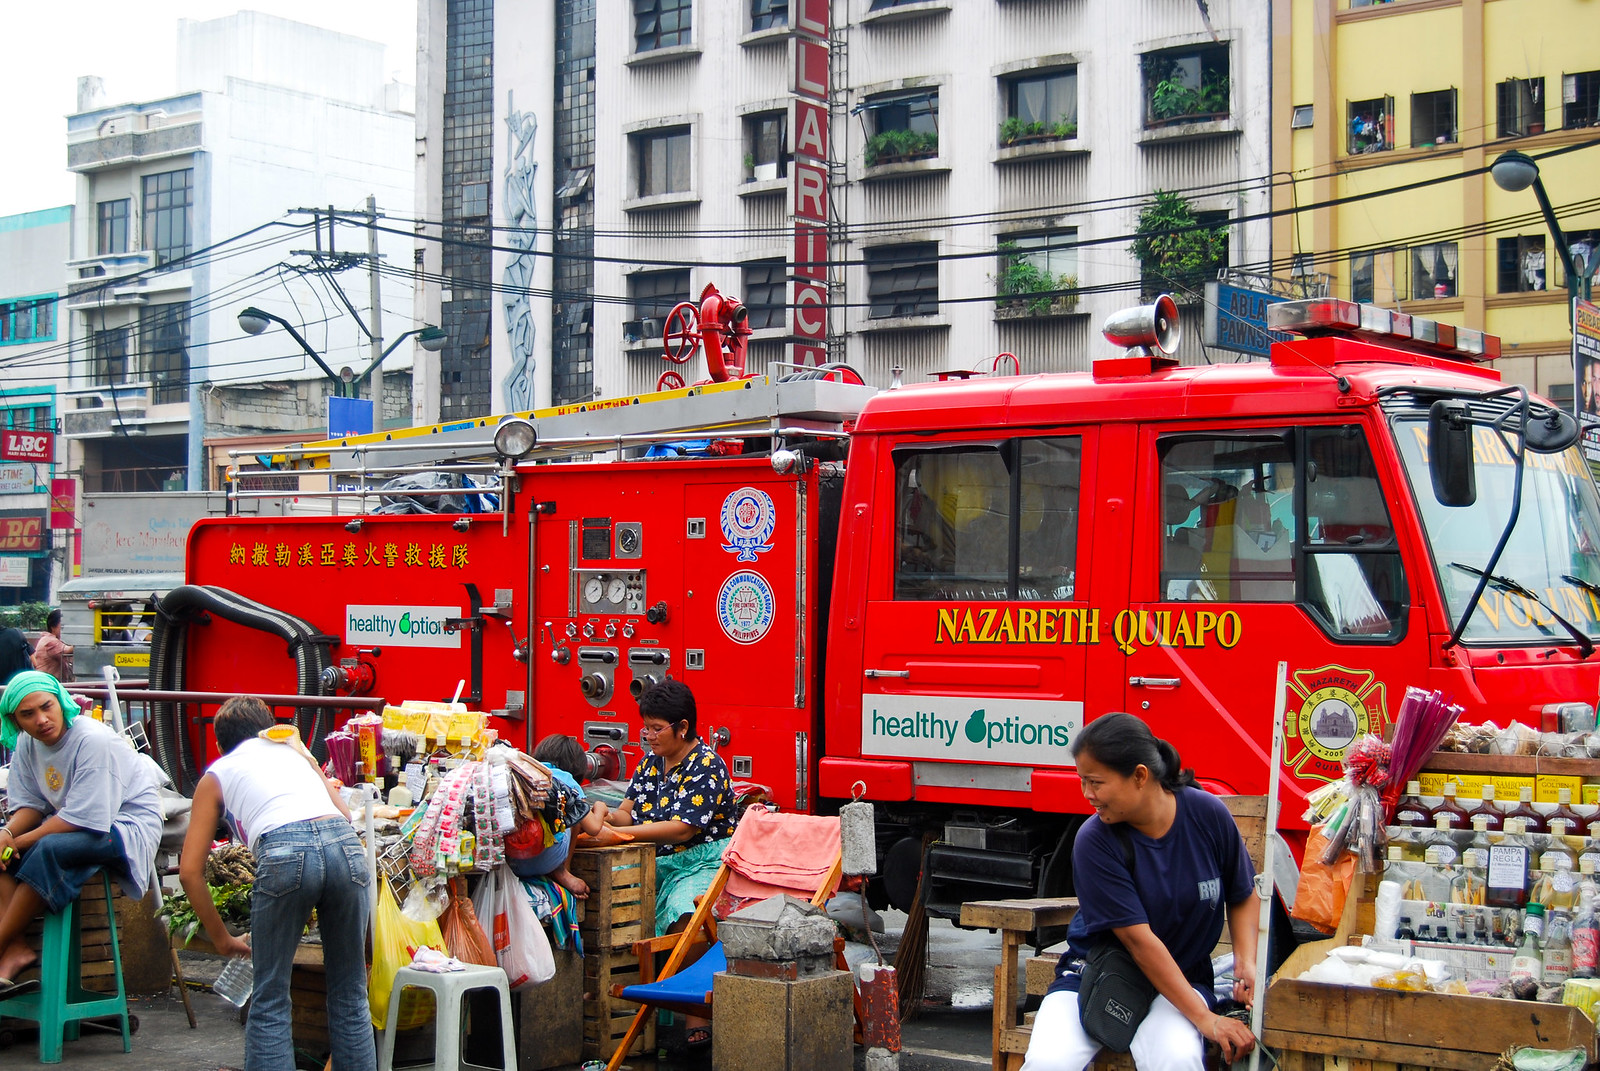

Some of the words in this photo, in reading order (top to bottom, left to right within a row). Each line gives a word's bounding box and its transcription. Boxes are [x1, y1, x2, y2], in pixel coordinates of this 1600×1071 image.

[1230, 292, 1274, 322] ABLA
[9, 435, 47, 452] LBC
[349, 614, 396, 637] healthy
[732, 628, 760, 640] PHILIPPINES
[935, 608, 1100, 644] NAZARETH
[1113, 609, 1243, 656] QUIAPO
[1310, 677, 1359, 690] NAZARETH
[872, 710, 958, 746] healthy
[1315, 761, 1341, 772] QUIA
[1418, 776, 1444, 786] MBONG
